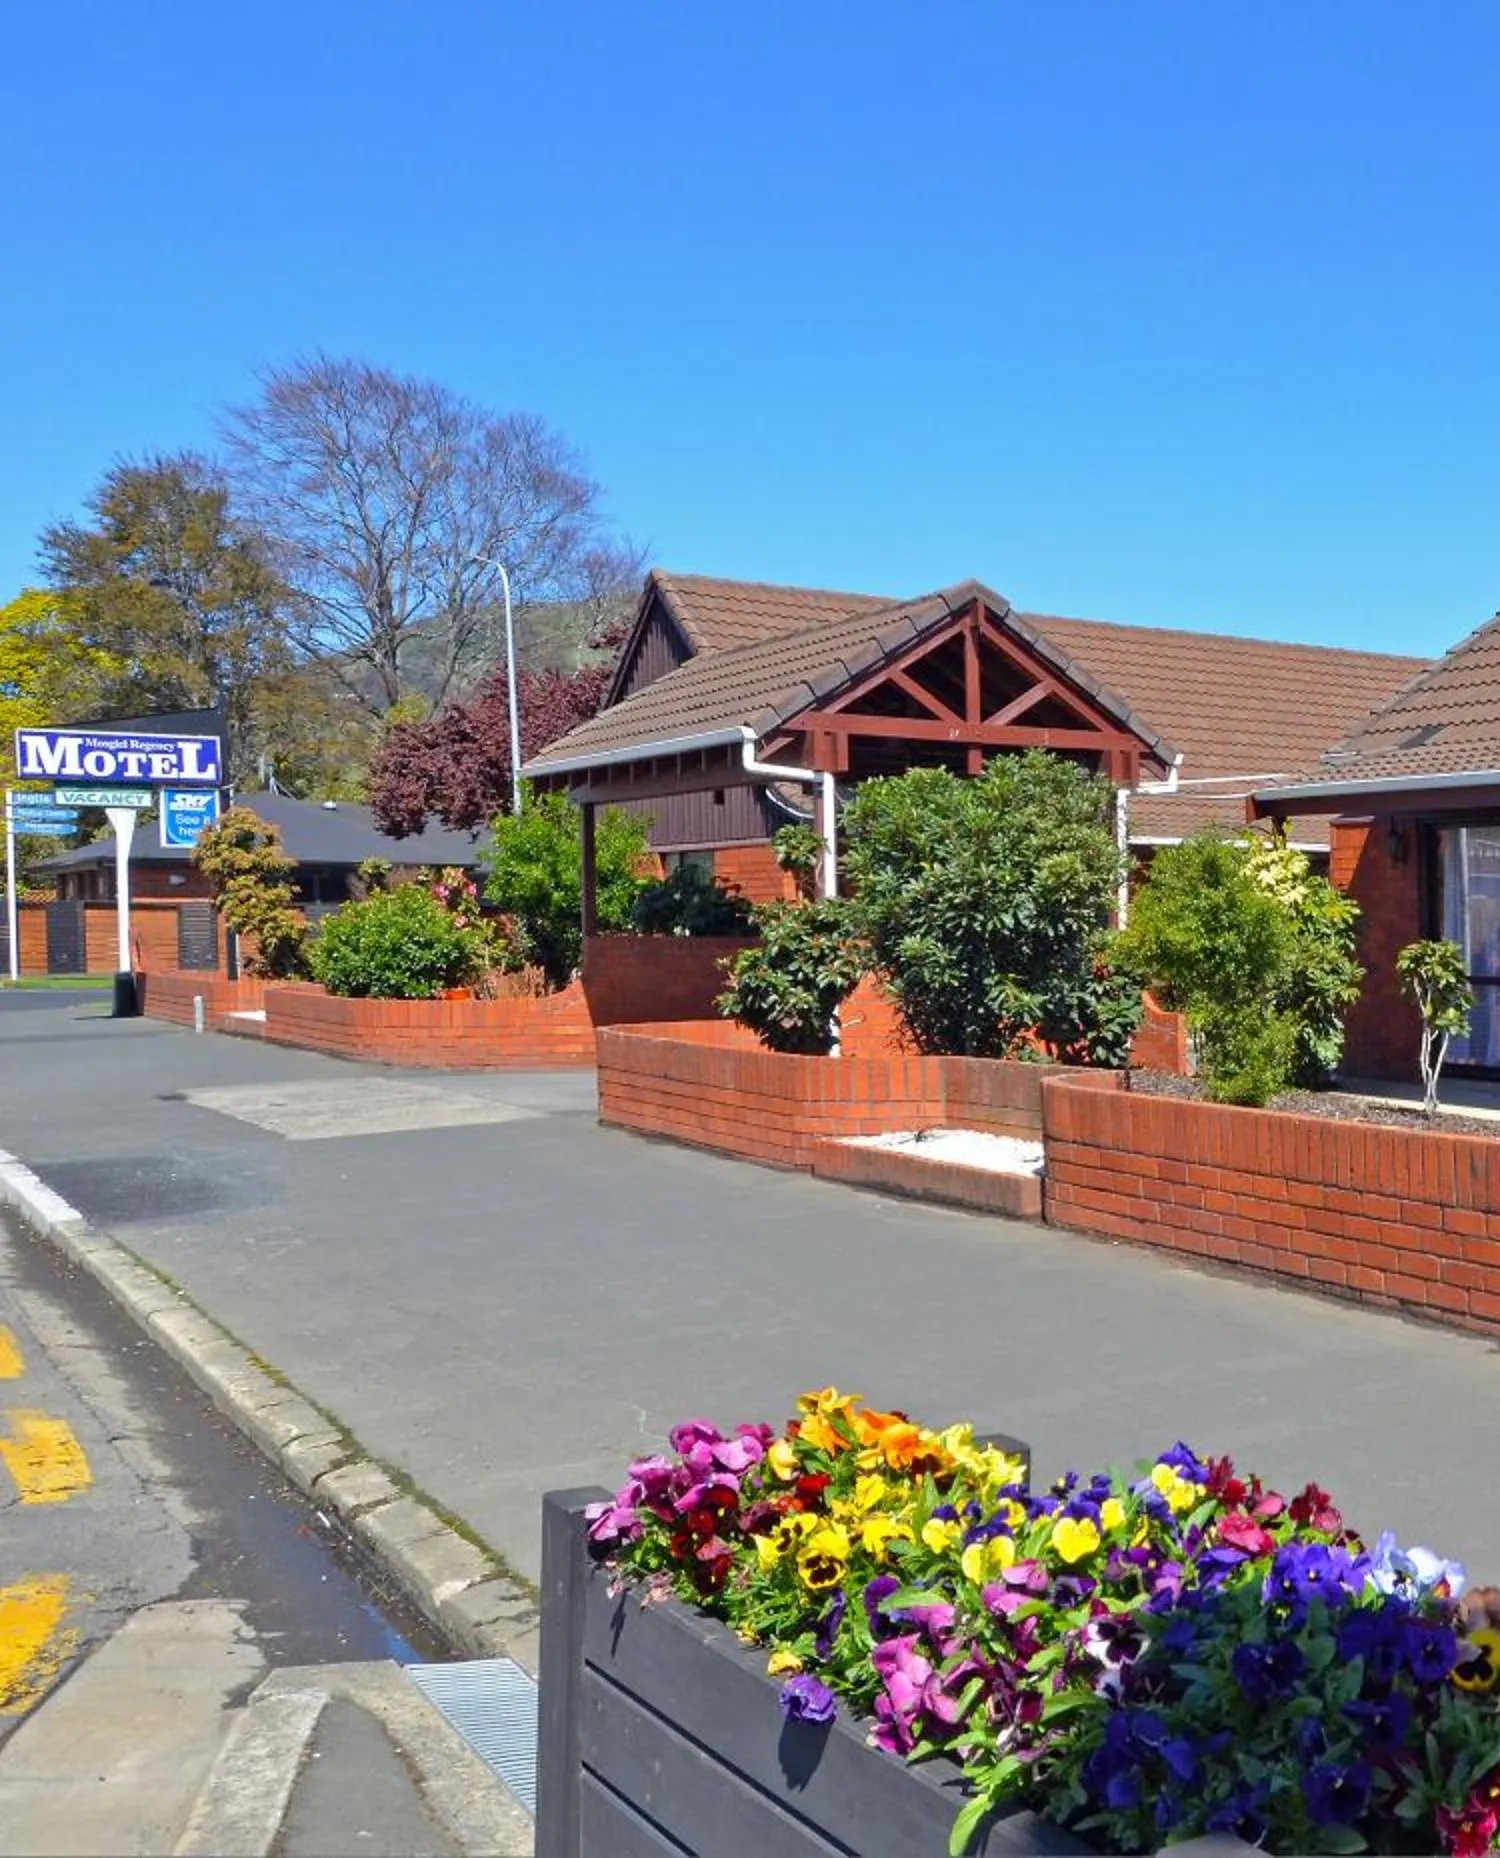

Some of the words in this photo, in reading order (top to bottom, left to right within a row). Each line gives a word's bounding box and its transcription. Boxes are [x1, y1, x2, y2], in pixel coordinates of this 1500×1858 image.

[21, 736, 216, 779] MOTEL
[63, 793, 145, 804] VACANCY
[175, 813, 200, 825] See
